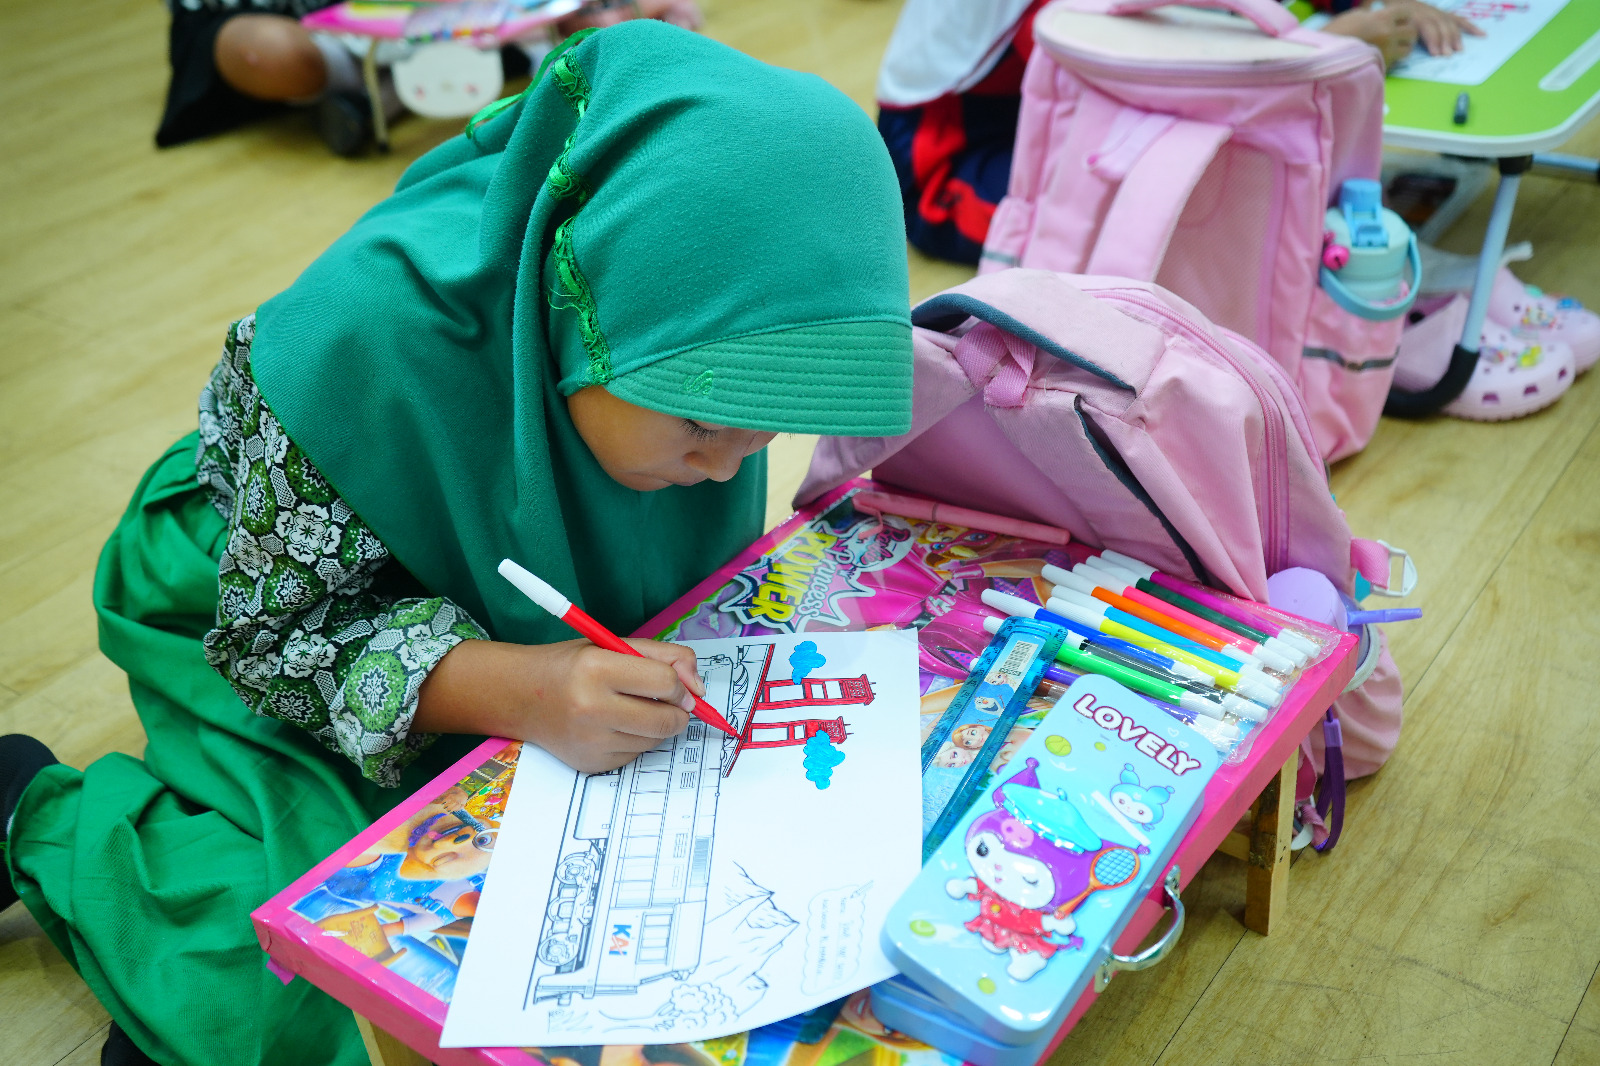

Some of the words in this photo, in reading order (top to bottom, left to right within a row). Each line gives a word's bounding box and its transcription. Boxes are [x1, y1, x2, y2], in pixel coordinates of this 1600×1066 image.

[748, 530, 837, 622] POWER
[1073, 693, 1201, 776] LOVELY
[609, 924, 632, 956] KAI
